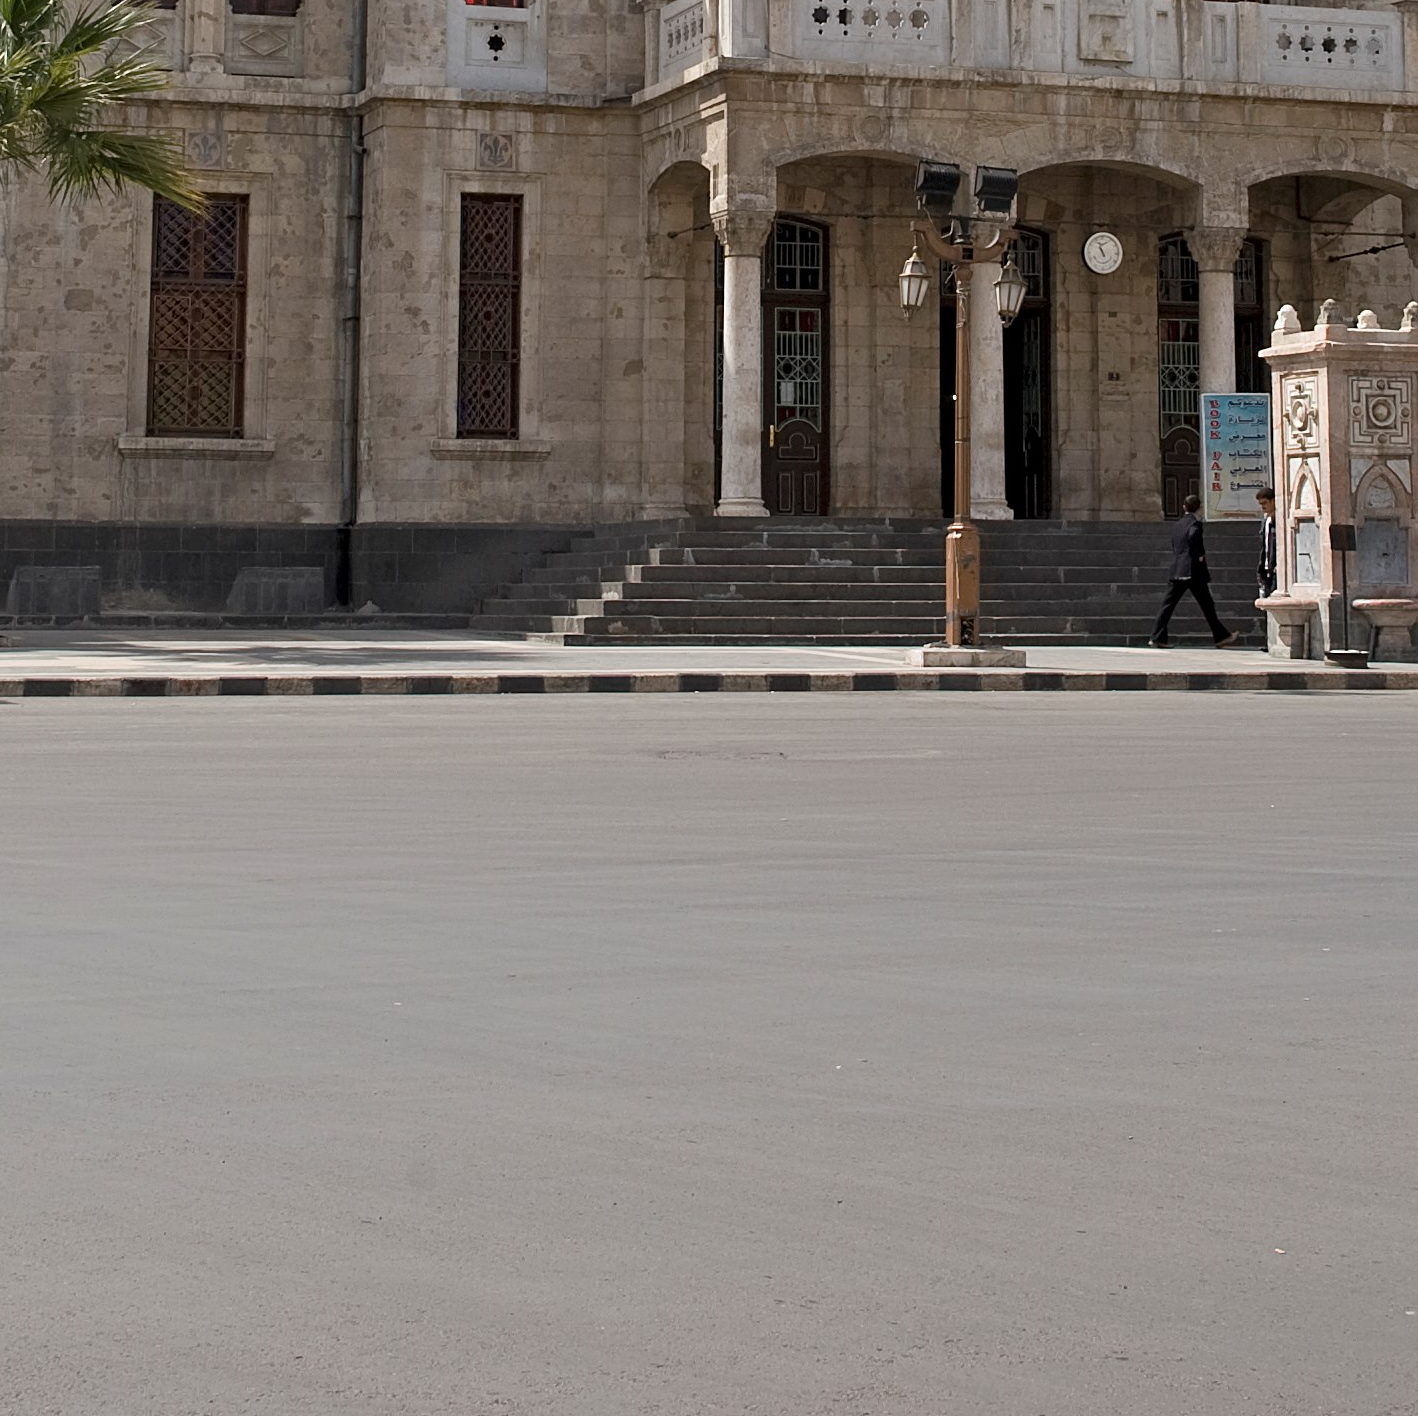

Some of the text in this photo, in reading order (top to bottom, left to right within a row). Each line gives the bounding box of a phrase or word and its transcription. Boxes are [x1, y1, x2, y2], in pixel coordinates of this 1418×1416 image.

[1209, 400, 1221, 440] BOOK
[1229, 431, 1266, 442] معرض
[1229, 449, 1266, 459] الكتاب
[1230, 465, 1267, 475] العربي
